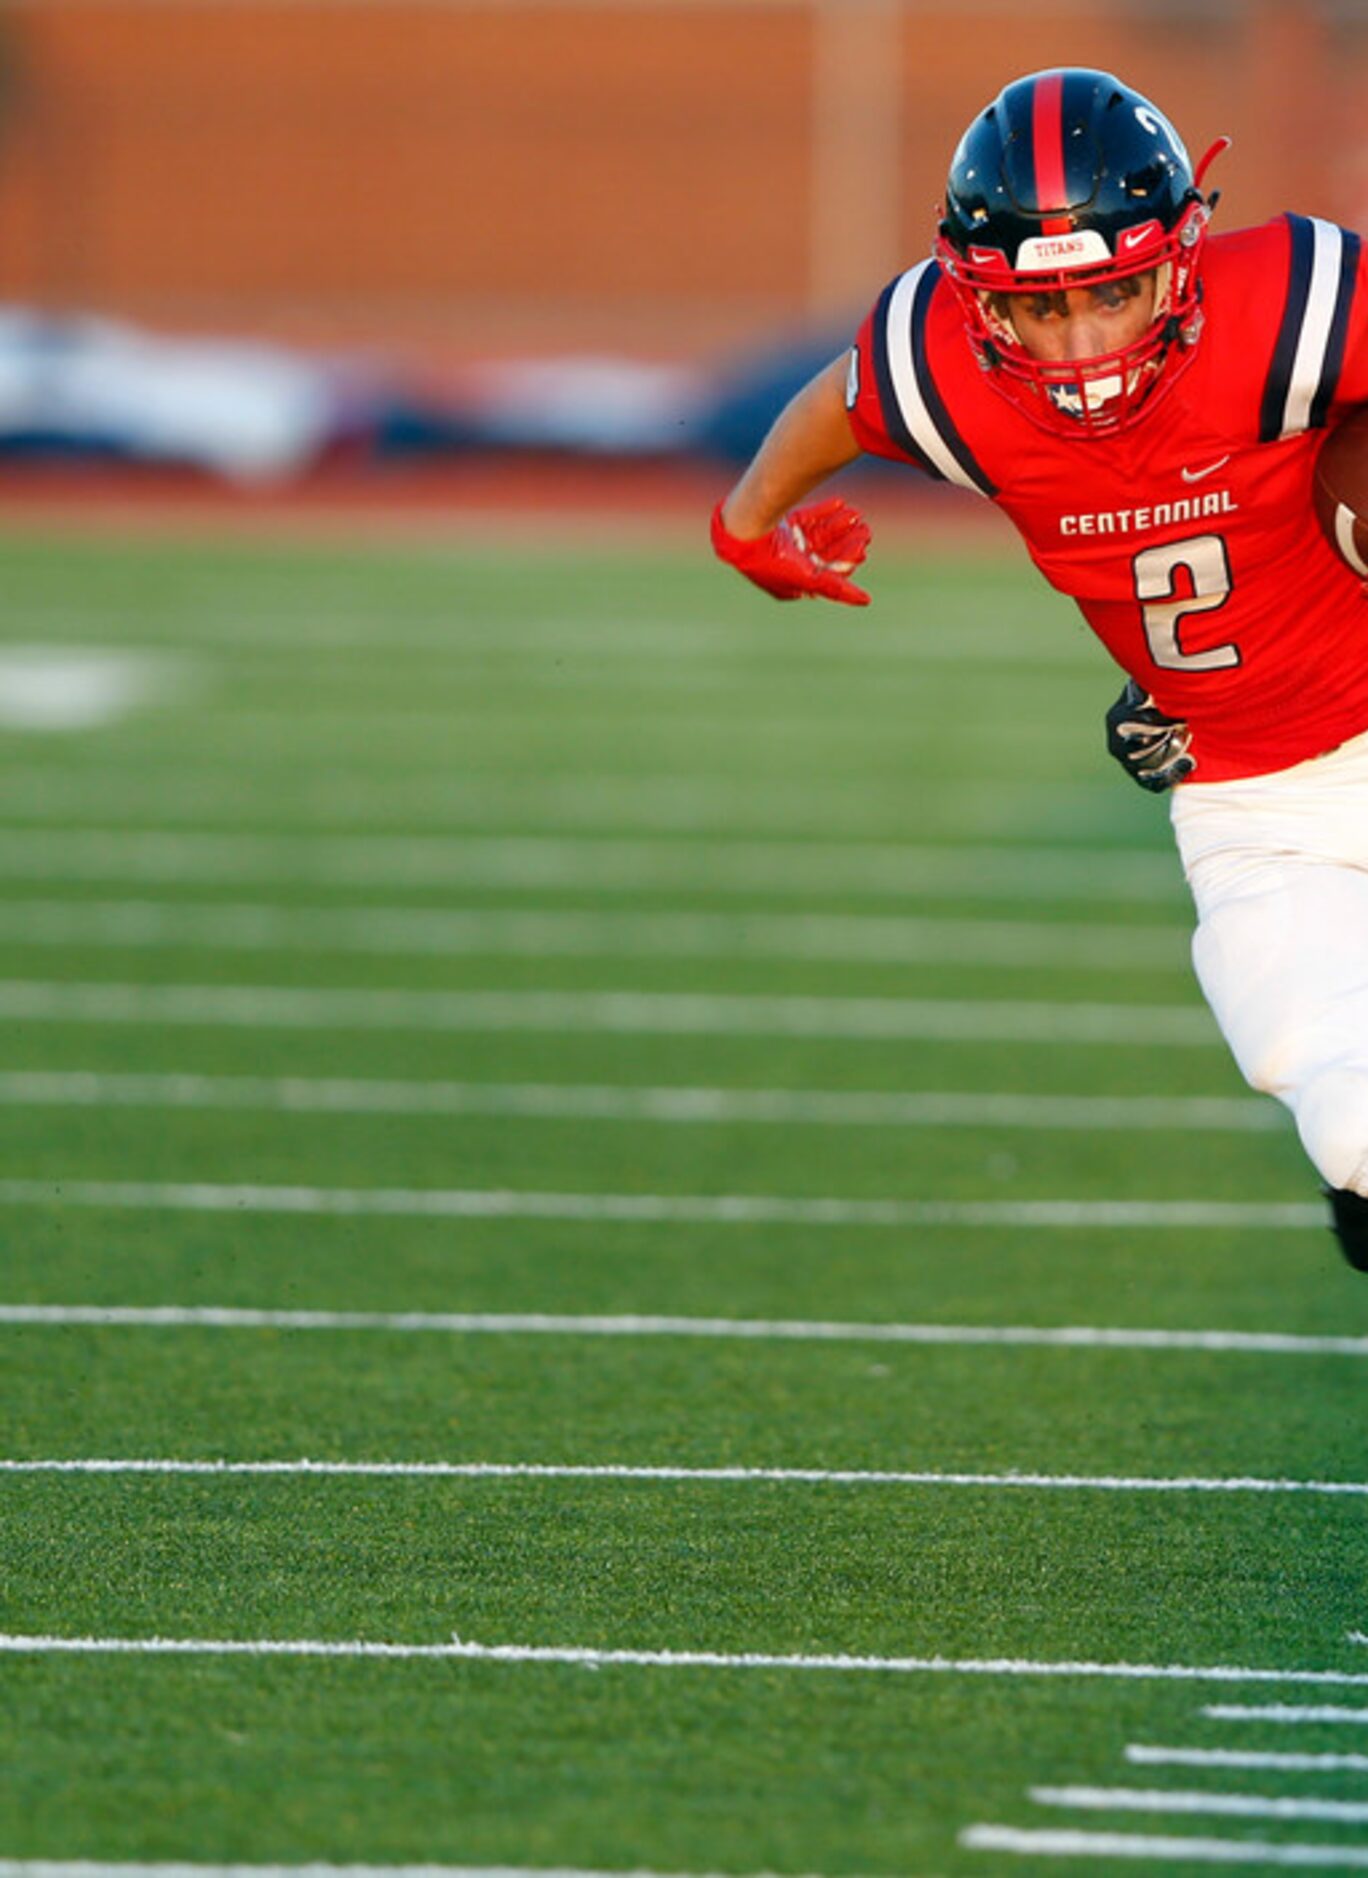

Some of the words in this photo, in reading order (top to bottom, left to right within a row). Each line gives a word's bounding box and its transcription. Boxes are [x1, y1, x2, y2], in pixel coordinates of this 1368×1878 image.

[1032, 237, 1085, 257] TITANS
[1060, 491, 1239, 536] CENTENNIAL
[1132, 533, 1242, 673] 2
